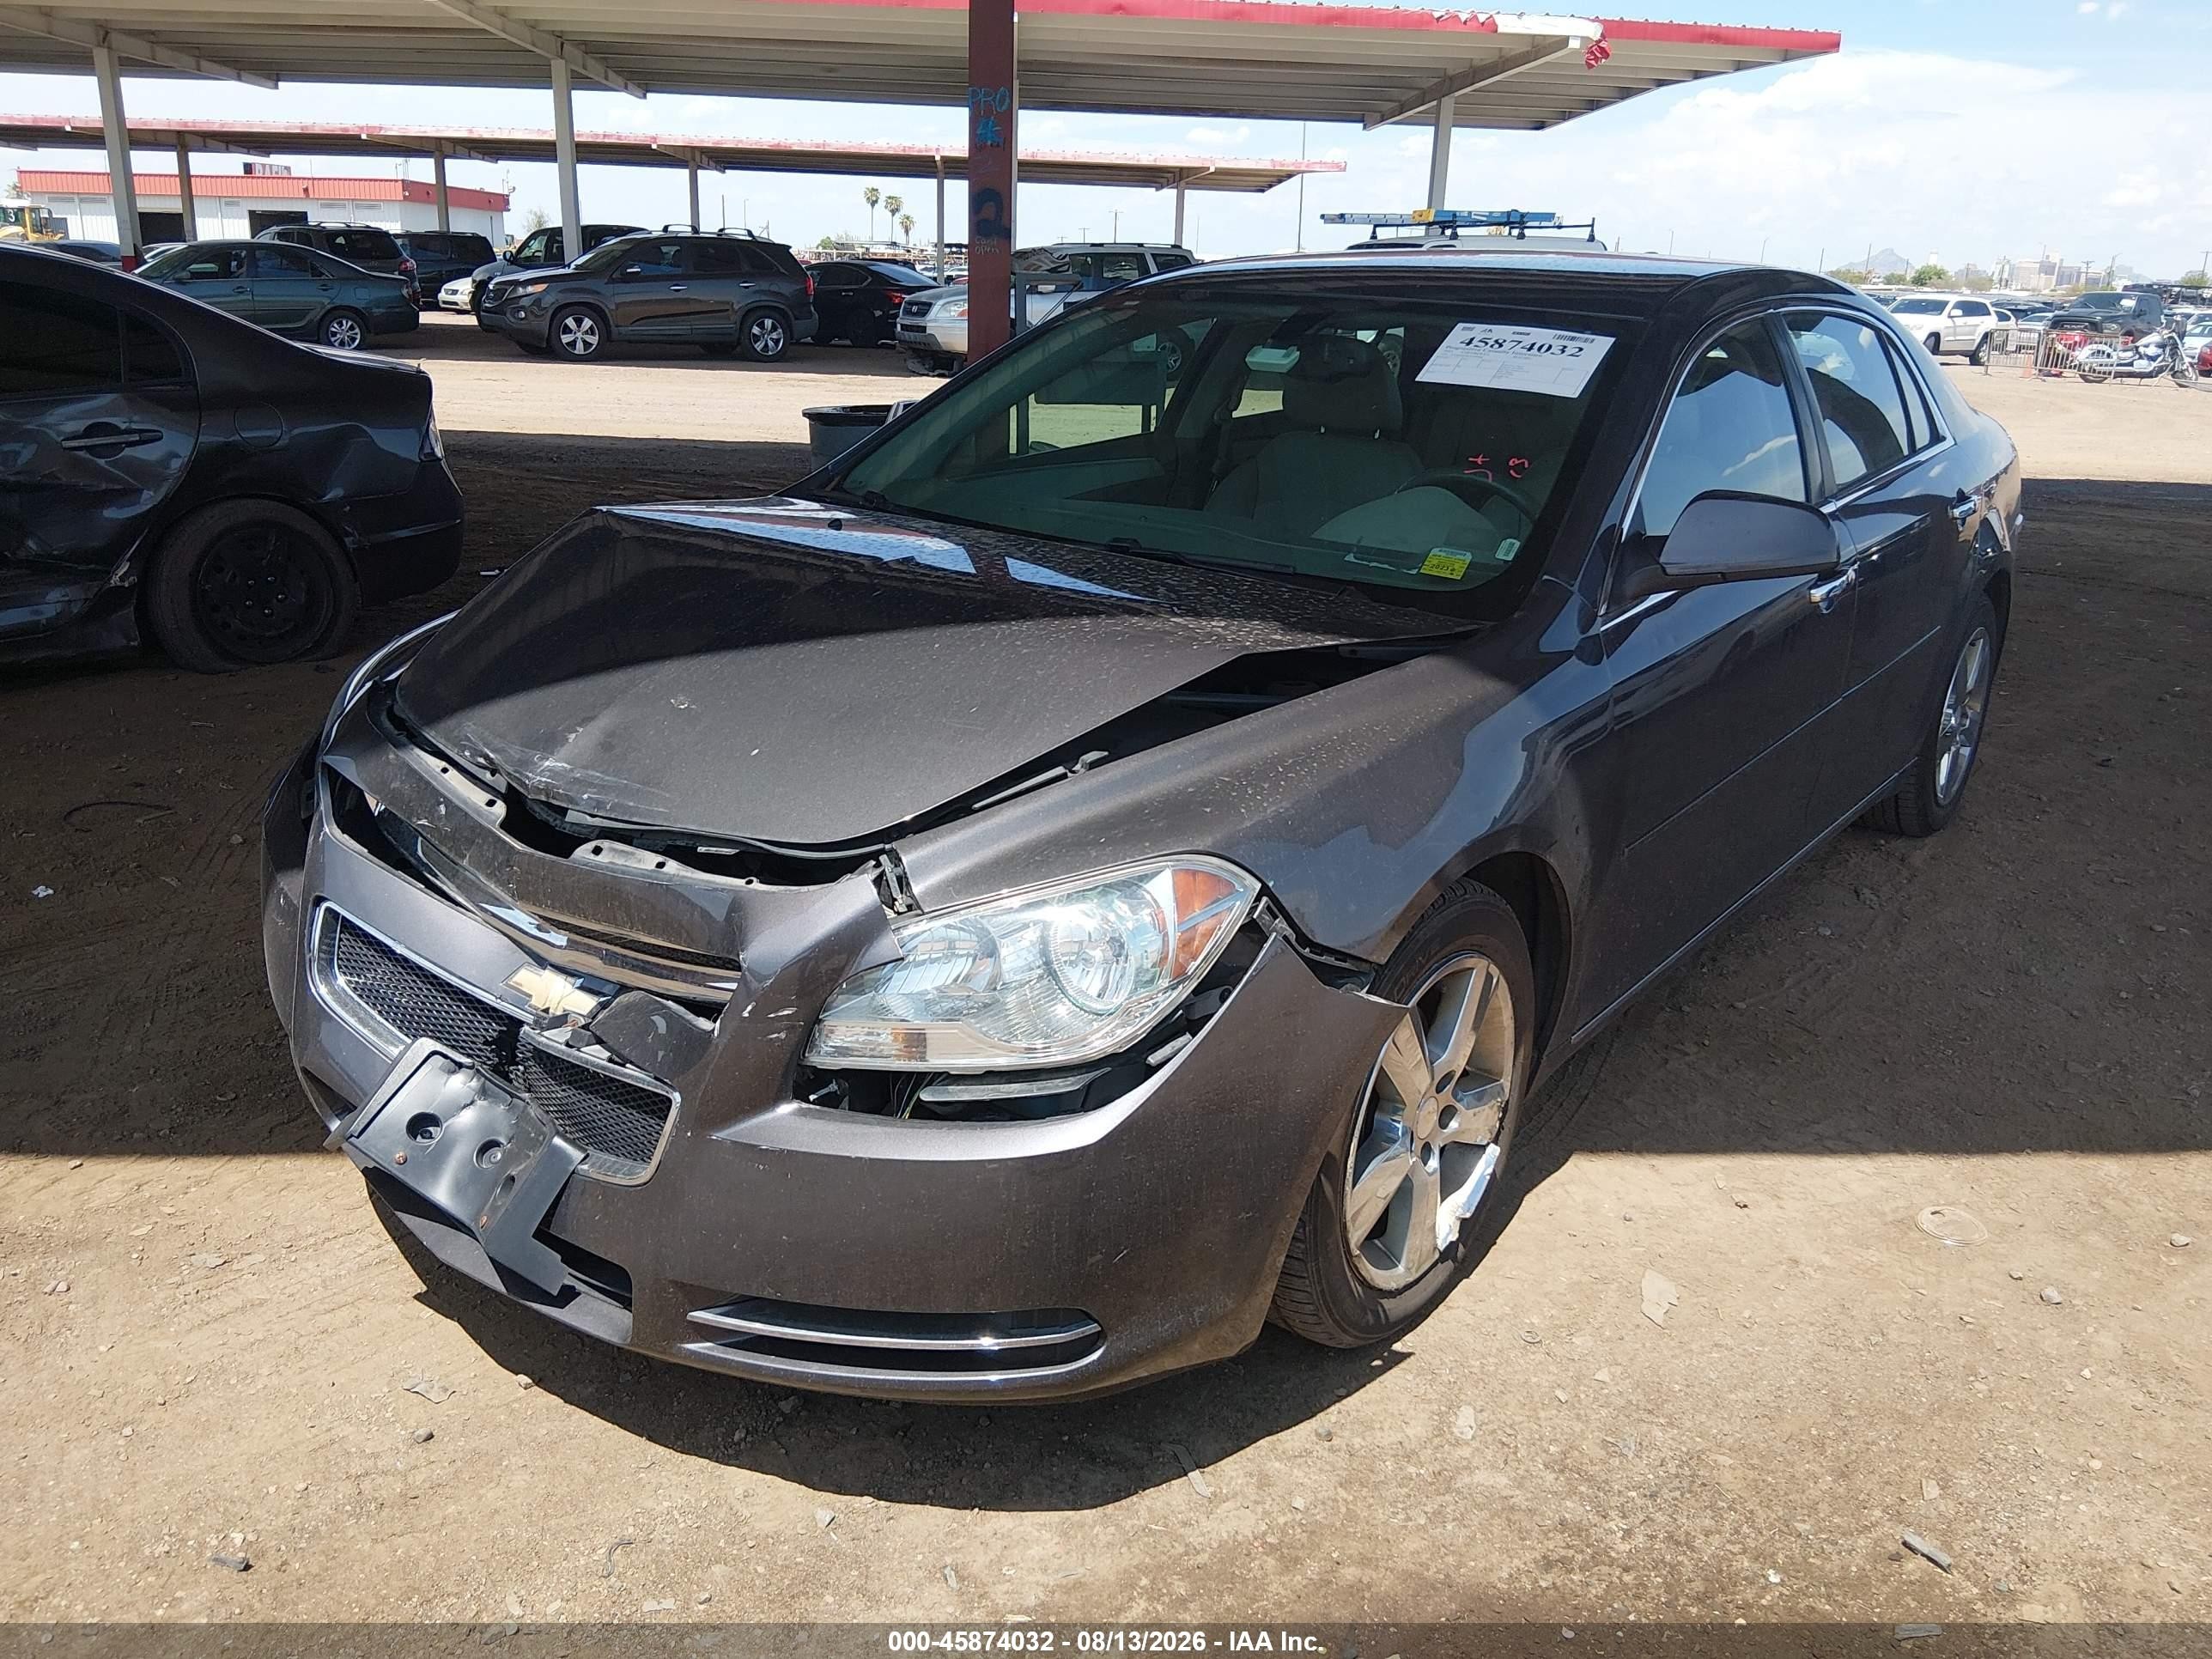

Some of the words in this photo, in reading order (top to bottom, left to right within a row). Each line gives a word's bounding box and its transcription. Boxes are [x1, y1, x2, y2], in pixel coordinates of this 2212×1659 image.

[969, 87, 1010, 114] PRO
[8, 209, 15, 222] 3
[973, 187, 1012, 240] 2
[1459, 336, 1584, 358] 45874032
